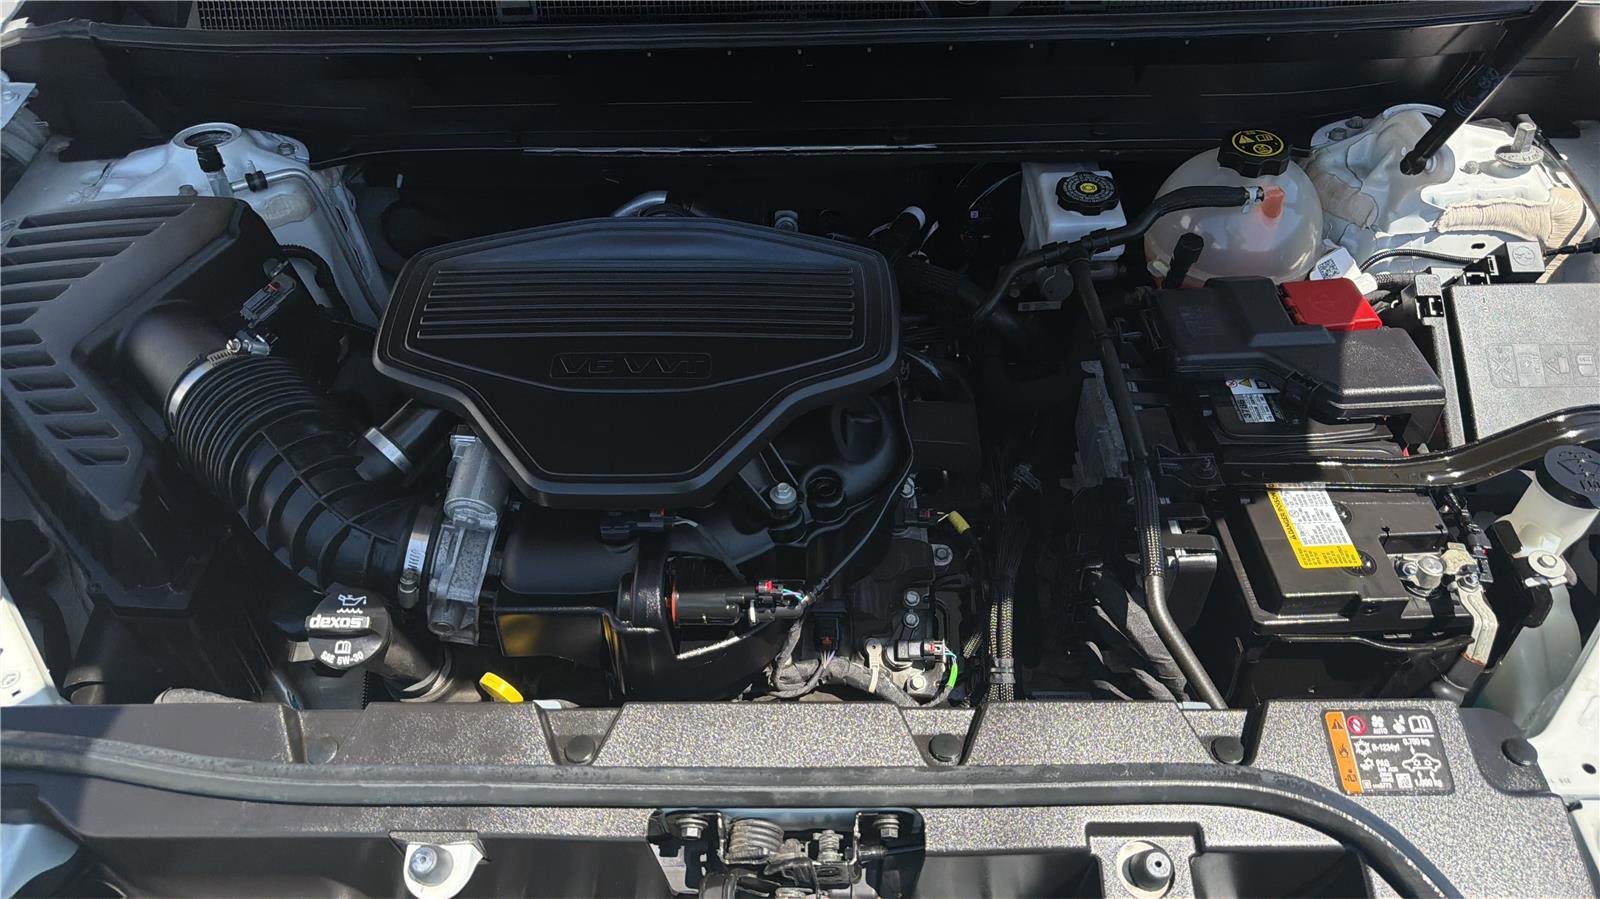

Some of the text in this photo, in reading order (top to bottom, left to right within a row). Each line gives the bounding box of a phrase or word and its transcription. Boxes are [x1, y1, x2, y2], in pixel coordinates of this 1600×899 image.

[559, 357, 705, 374] V6 VVT
[320, 650, 336, 664] SAE
